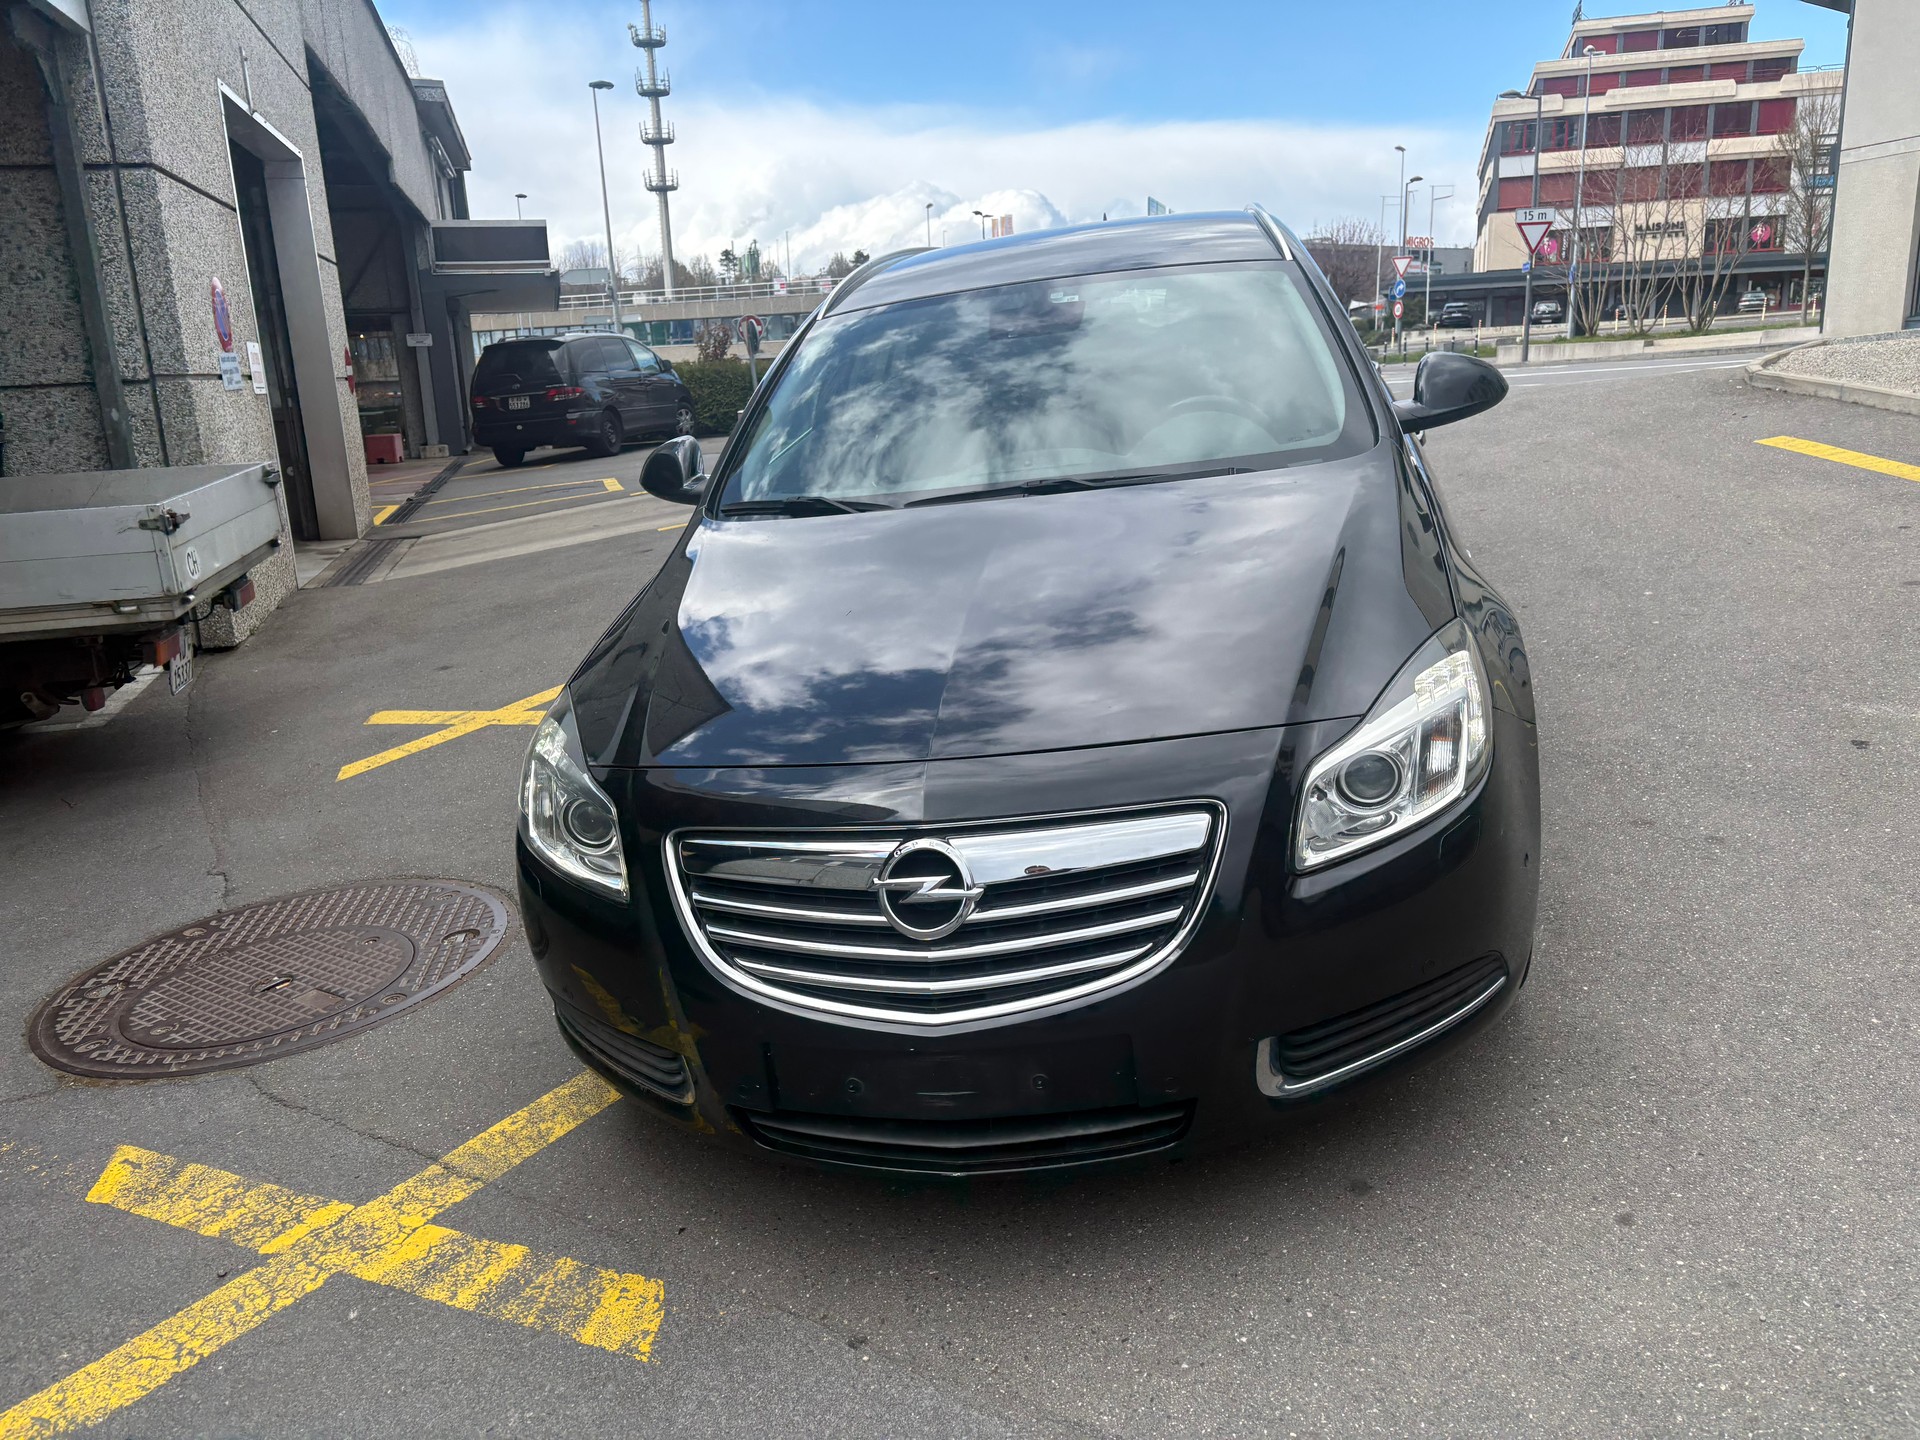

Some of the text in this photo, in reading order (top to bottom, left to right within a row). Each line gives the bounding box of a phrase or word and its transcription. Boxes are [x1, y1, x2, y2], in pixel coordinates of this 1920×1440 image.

[1523, 210, 1547, 221] 15 m
[186, 549, 200, 577] CH
